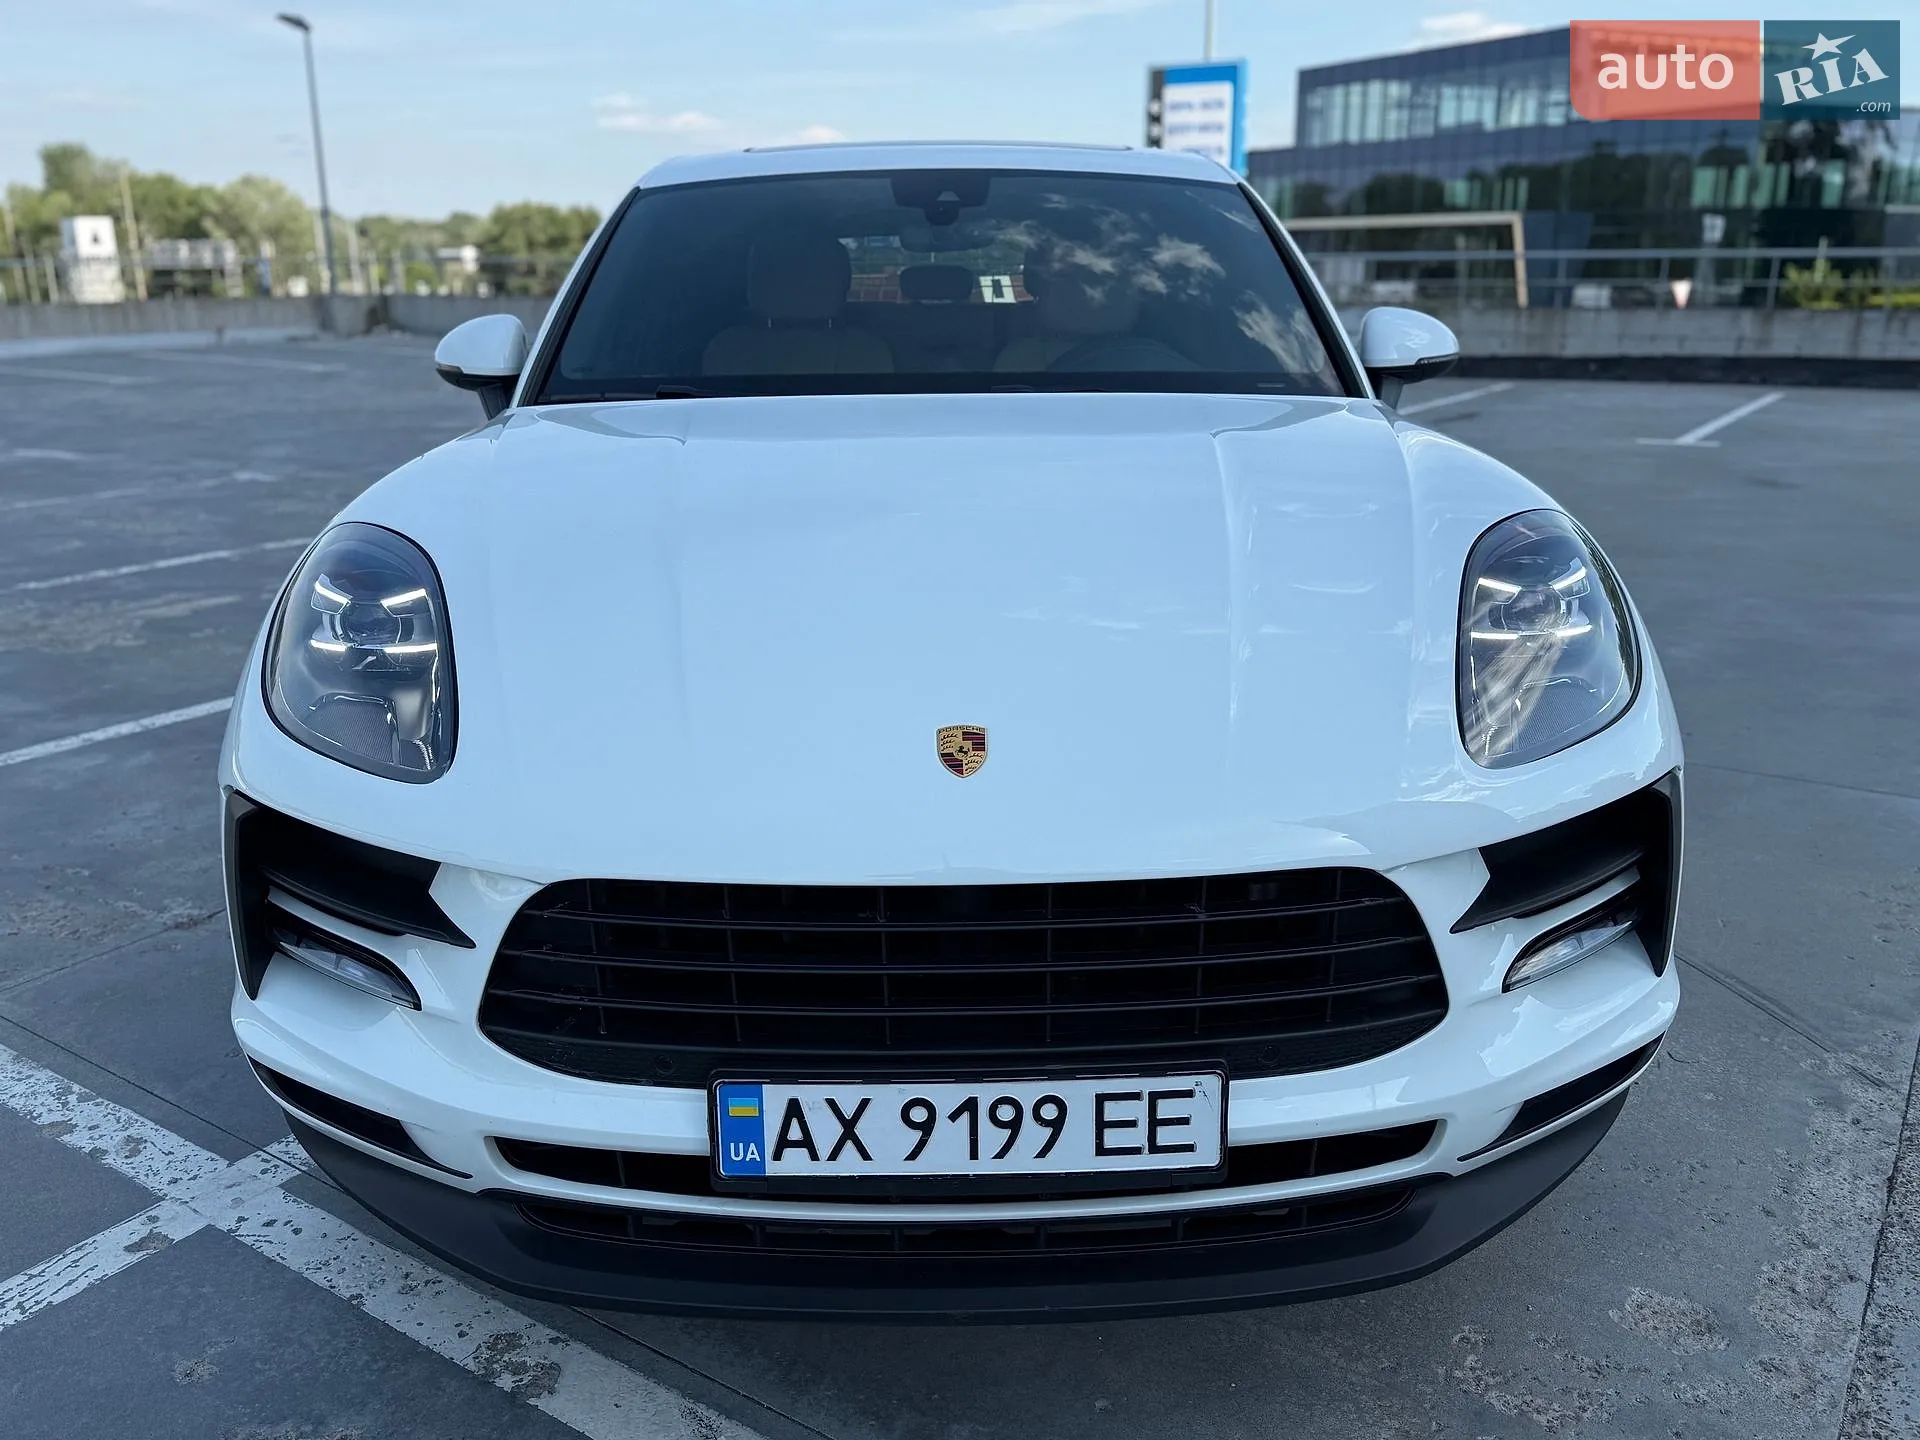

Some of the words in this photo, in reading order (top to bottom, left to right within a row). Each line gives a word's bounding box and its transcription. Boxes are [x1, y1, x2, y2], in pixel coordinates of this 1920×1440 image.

[938, 725, 985, 734] PORSCHE
[771, 1096, 873, 1162] AX
[899, 1094, 1069, 1162] 9199
[1094, 1088, 1197, 1158] EE
[730, 1142, 761, 1162] UA
